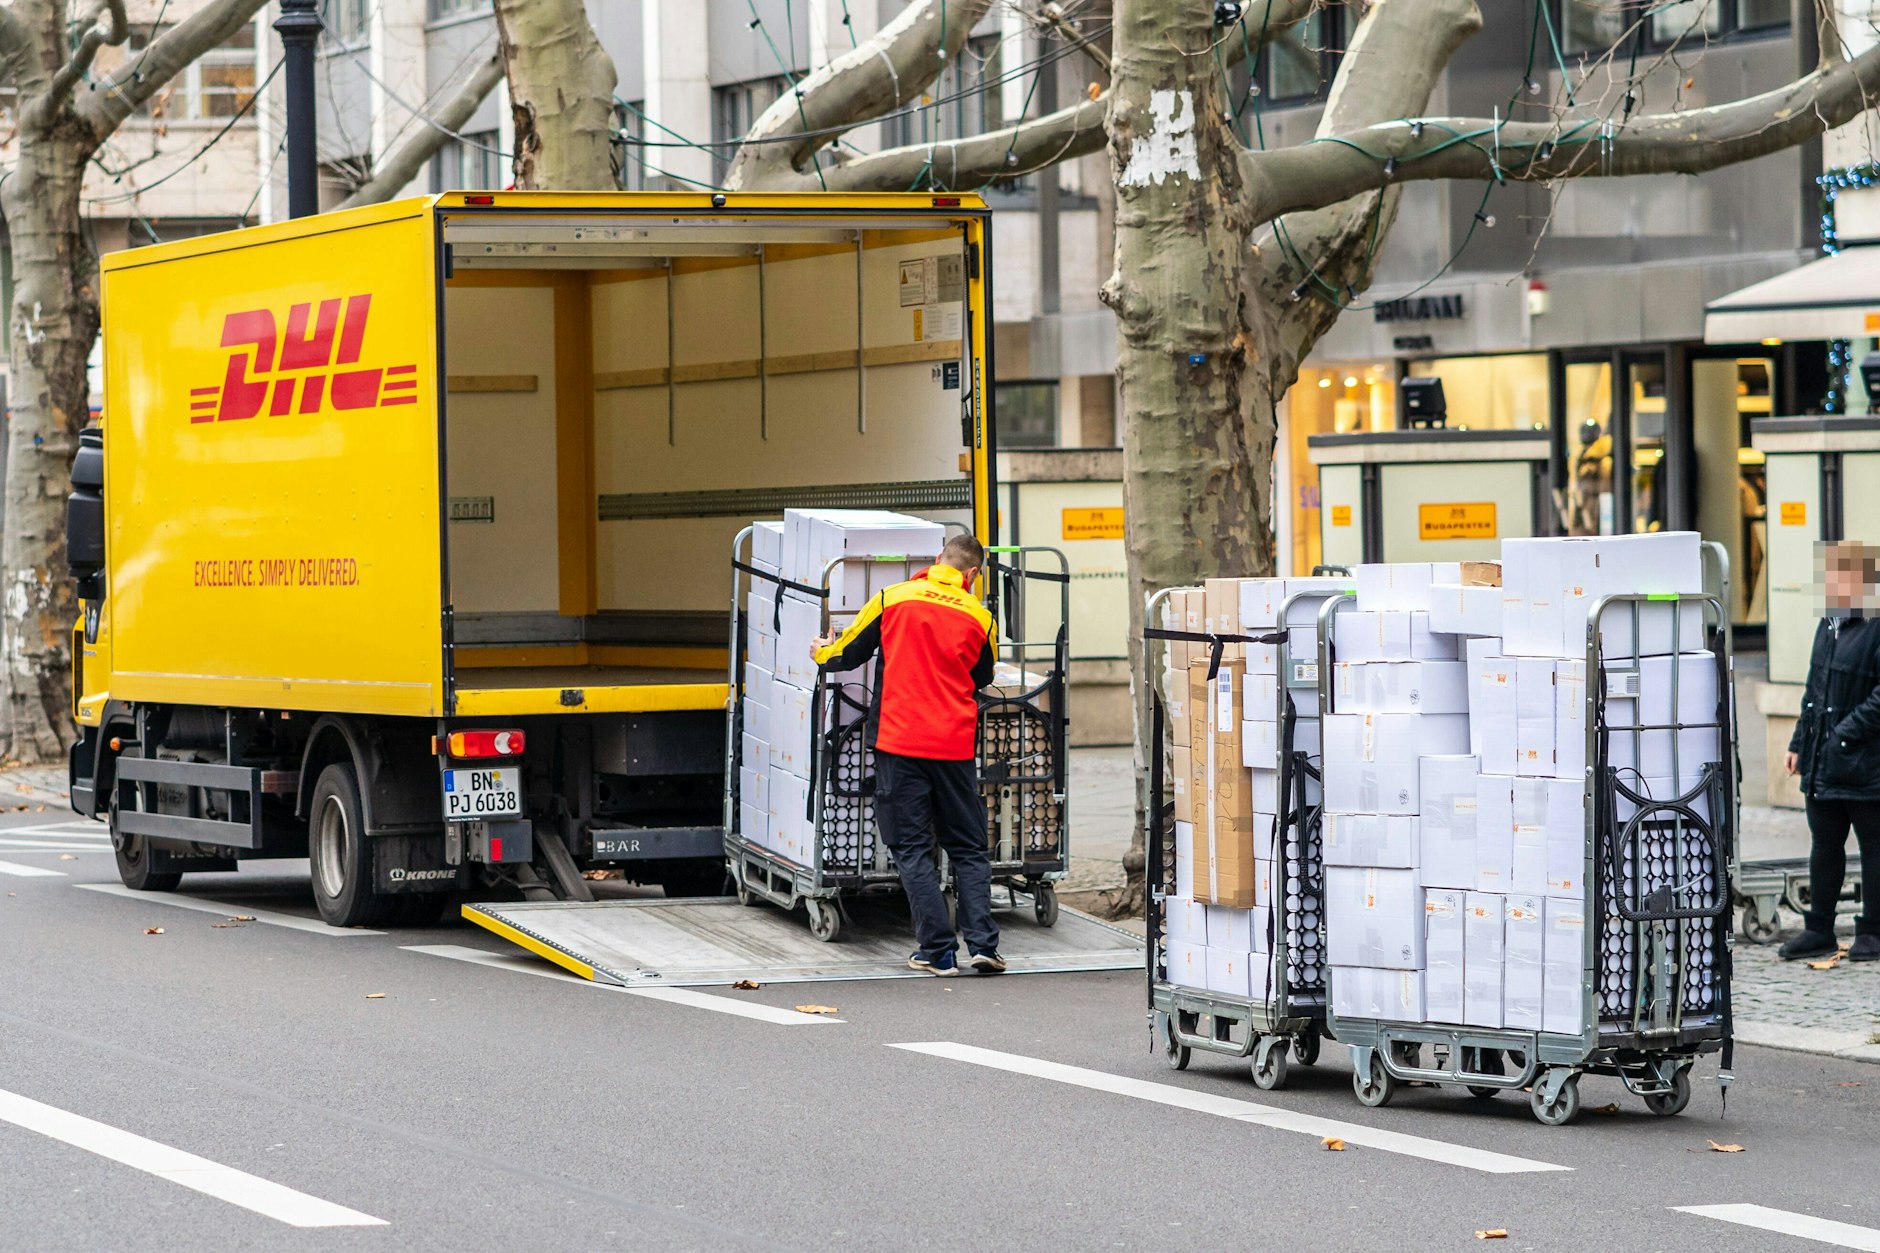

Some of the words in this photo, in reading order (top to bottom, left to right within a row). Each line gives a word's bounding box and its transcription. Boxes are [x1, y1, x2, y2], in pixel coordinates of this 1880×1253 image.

[217, 293, 384, 421] DHL
[194, 560, 256, 587] EXCELLENCE.
[259, 559, 296, 586] SIMPLY
[299, 558, 360, 586] DELIVERED.
[924, 590, 965, 606] DHL
[471, 771, 493, 791] BN
[449, 793, 471, 814] PJ
[476, 791, 516, 812] 6038
[406, 870, 457, 880] KRONE
